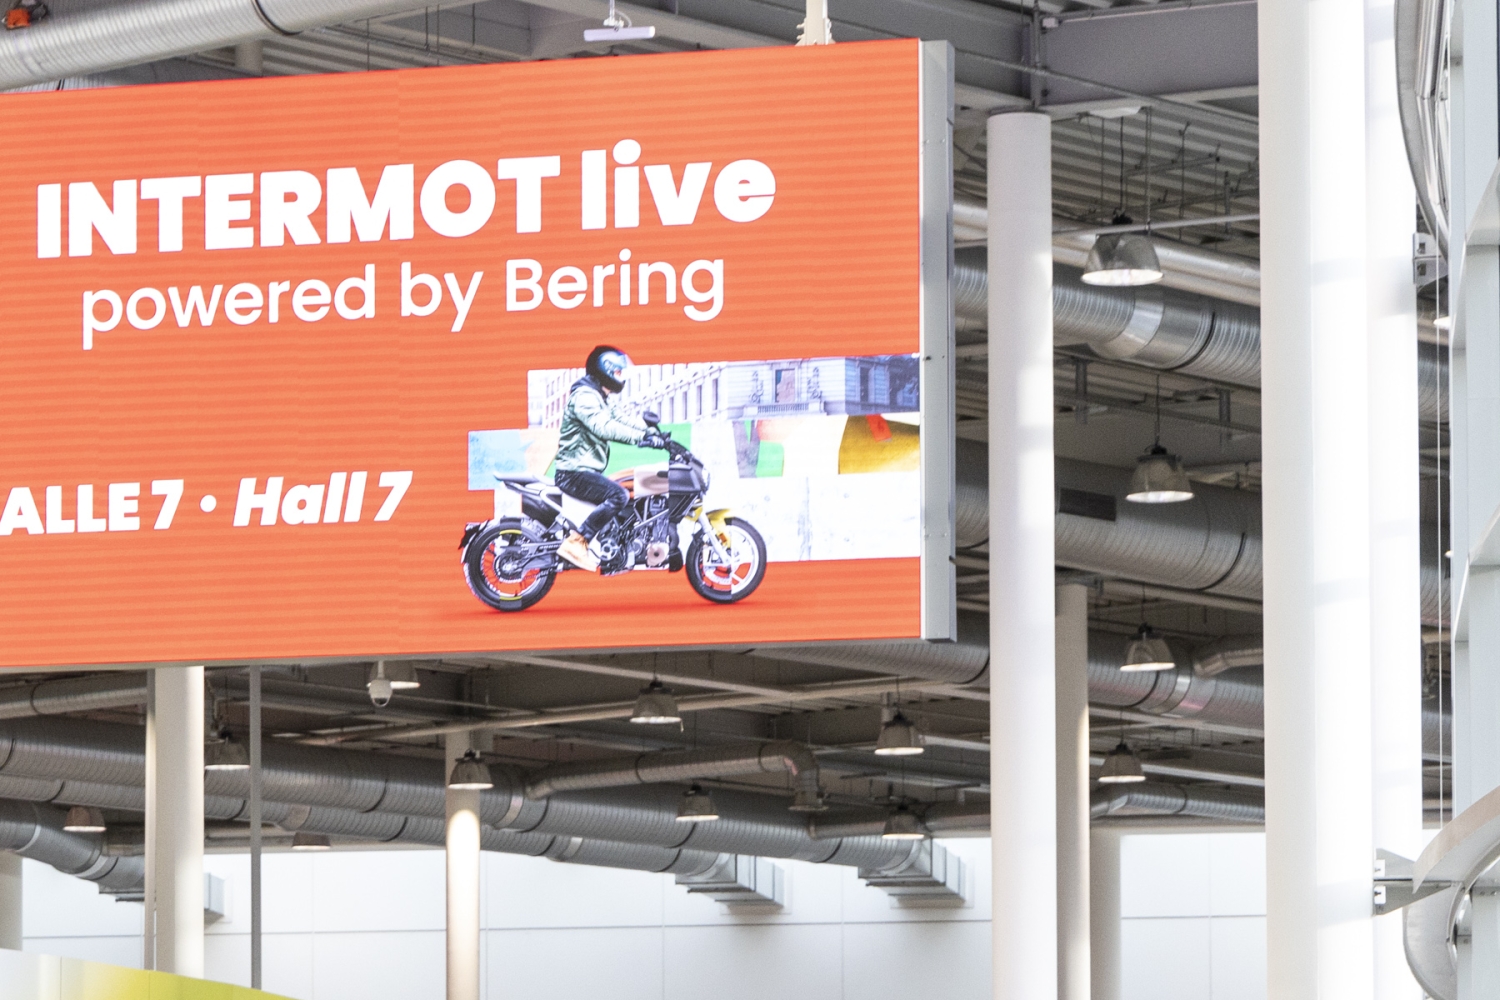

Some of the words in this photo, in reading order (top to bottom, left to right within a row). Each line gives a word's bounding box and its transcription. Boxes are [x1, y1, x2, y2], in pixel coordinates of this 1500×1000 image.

[37, 156, 560, 258] INTERMOT
[581, 138, 776, 231] live
[83, 263, 376, 351] powered
[400, 259, 483, 333] by
[505, 248, 724, 322] Bering
[152, 478, 184, 531] 7
[232, 470, 367, 527] Hall
[374, 470, 414, 522] 7
